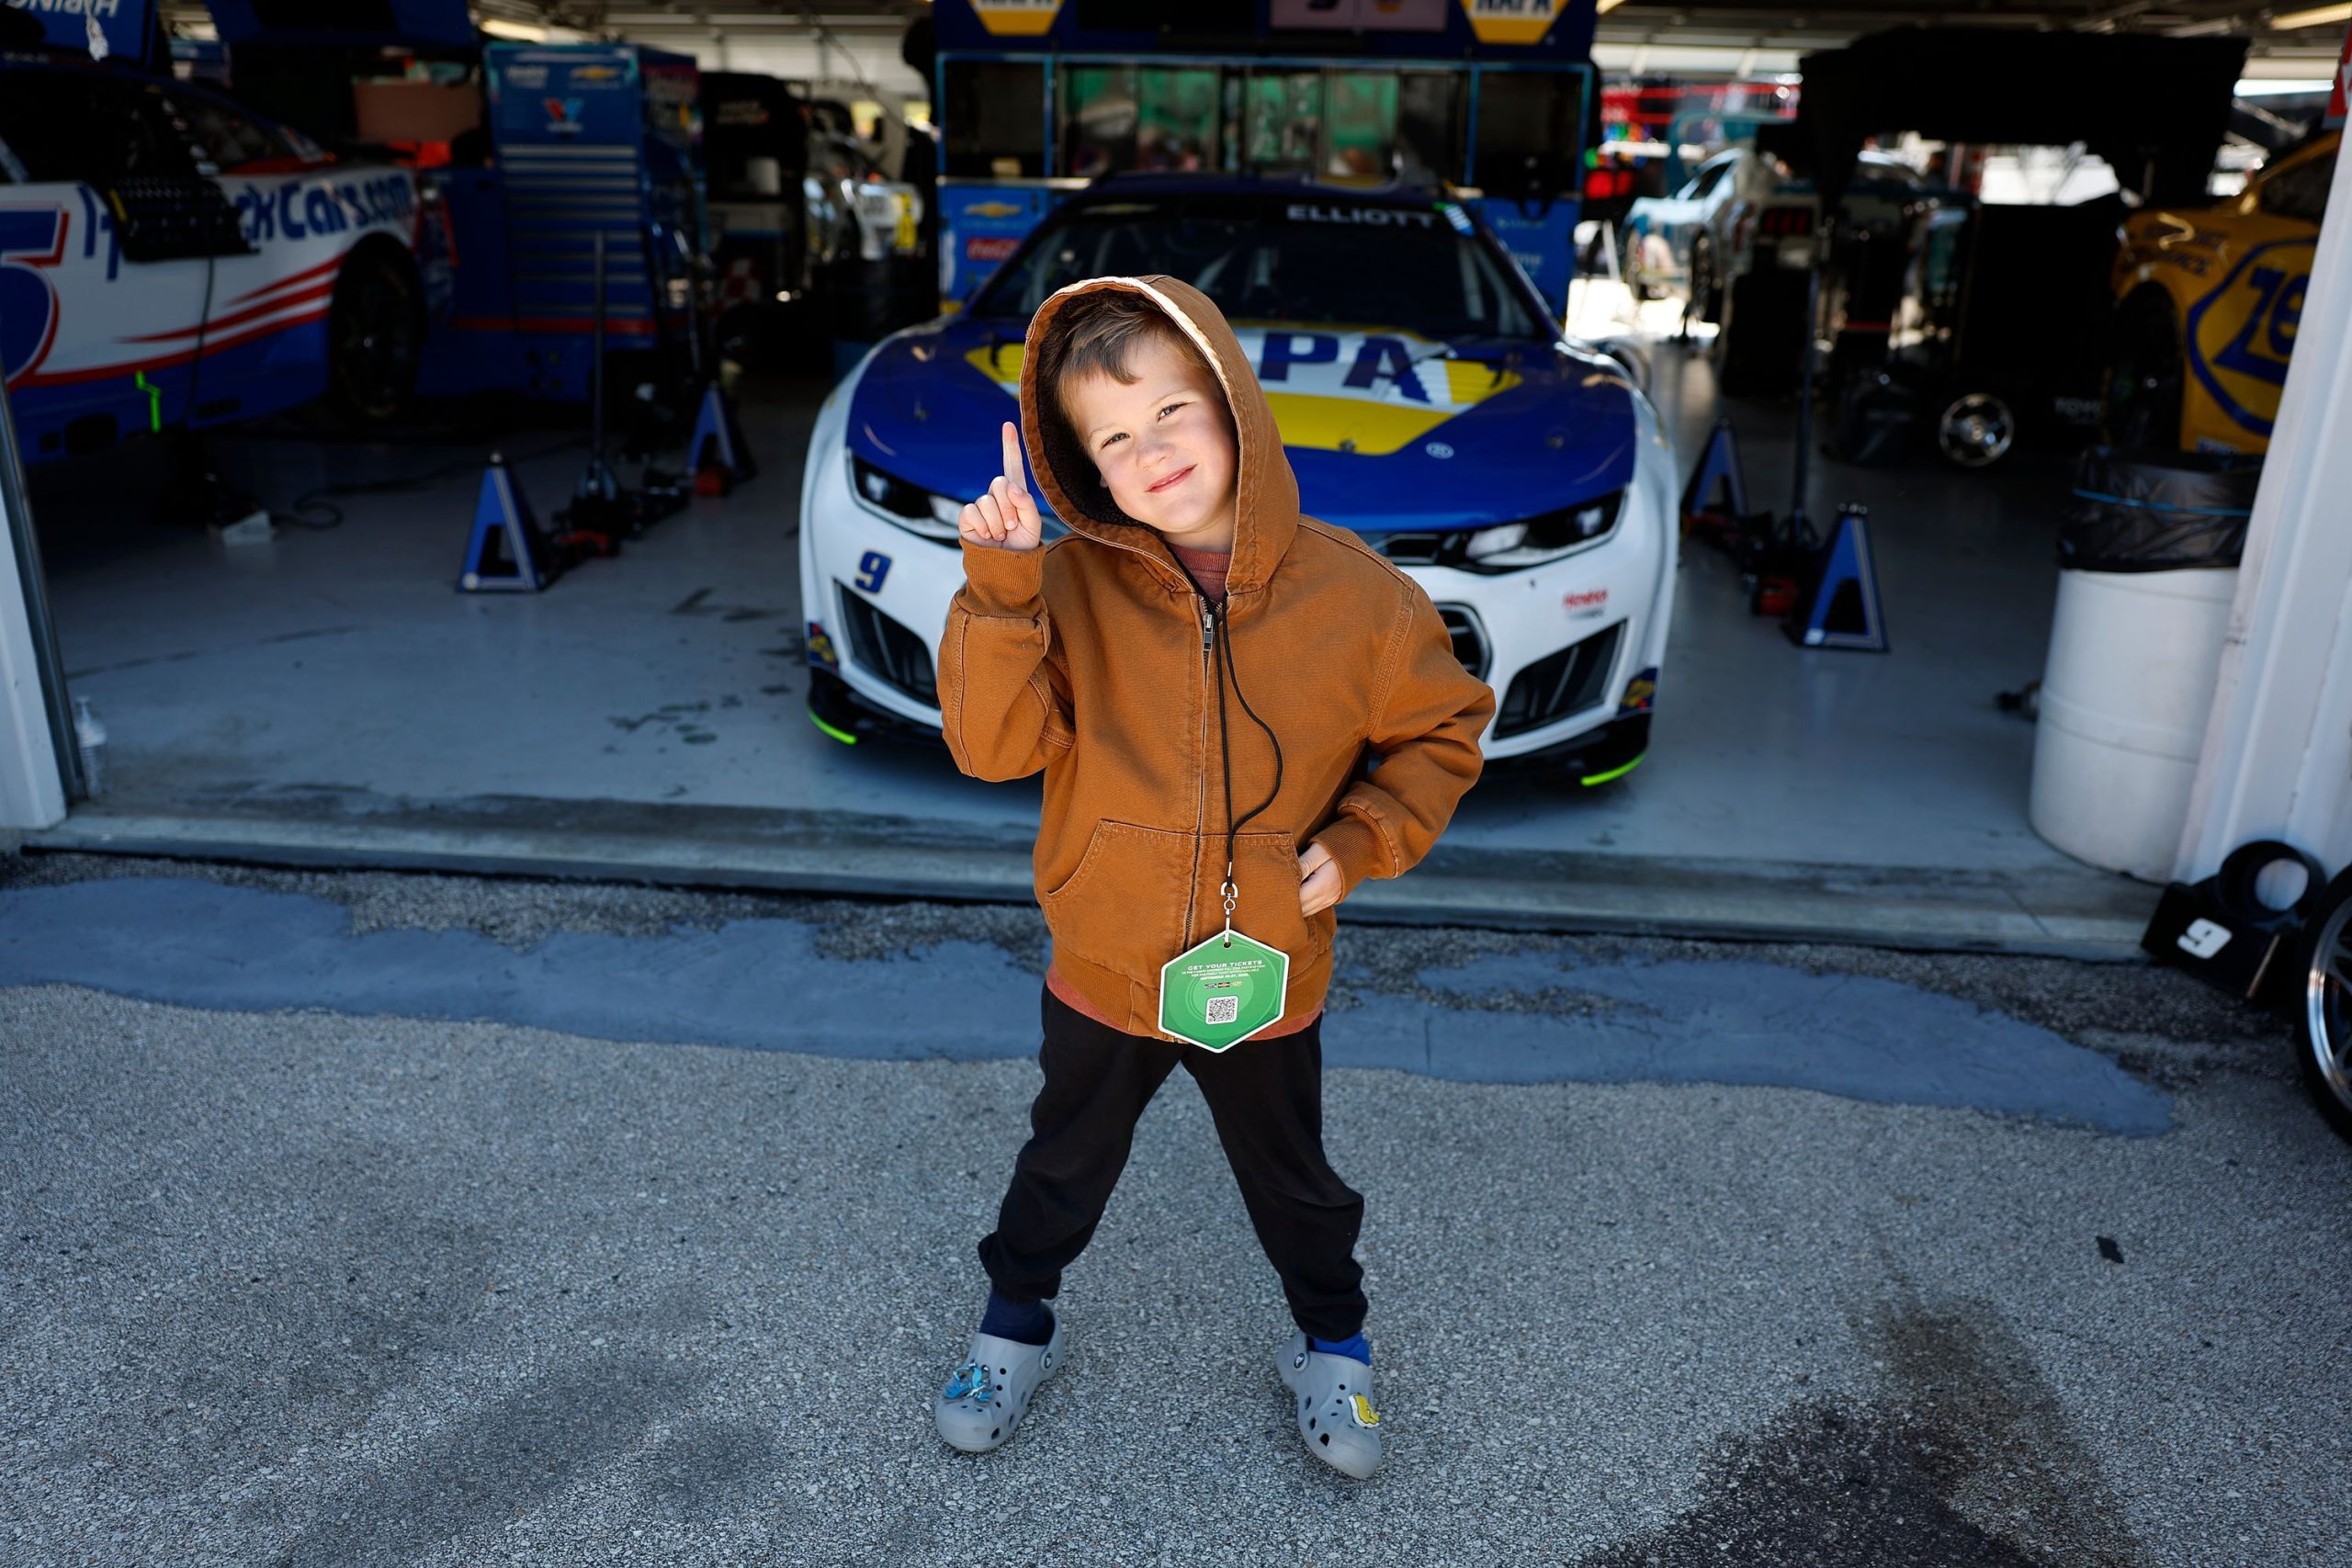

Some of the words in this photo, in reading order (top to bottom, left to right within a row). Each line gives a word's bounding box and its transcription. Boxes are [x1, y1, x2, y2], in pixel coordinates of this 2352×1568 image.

[1286, 204, 1435, 229] ELLIOTT
[1259, 332, 1432, 404] PA
[854, 550, 892, 593] 9
[2177, 917, 2233, 960] 9
